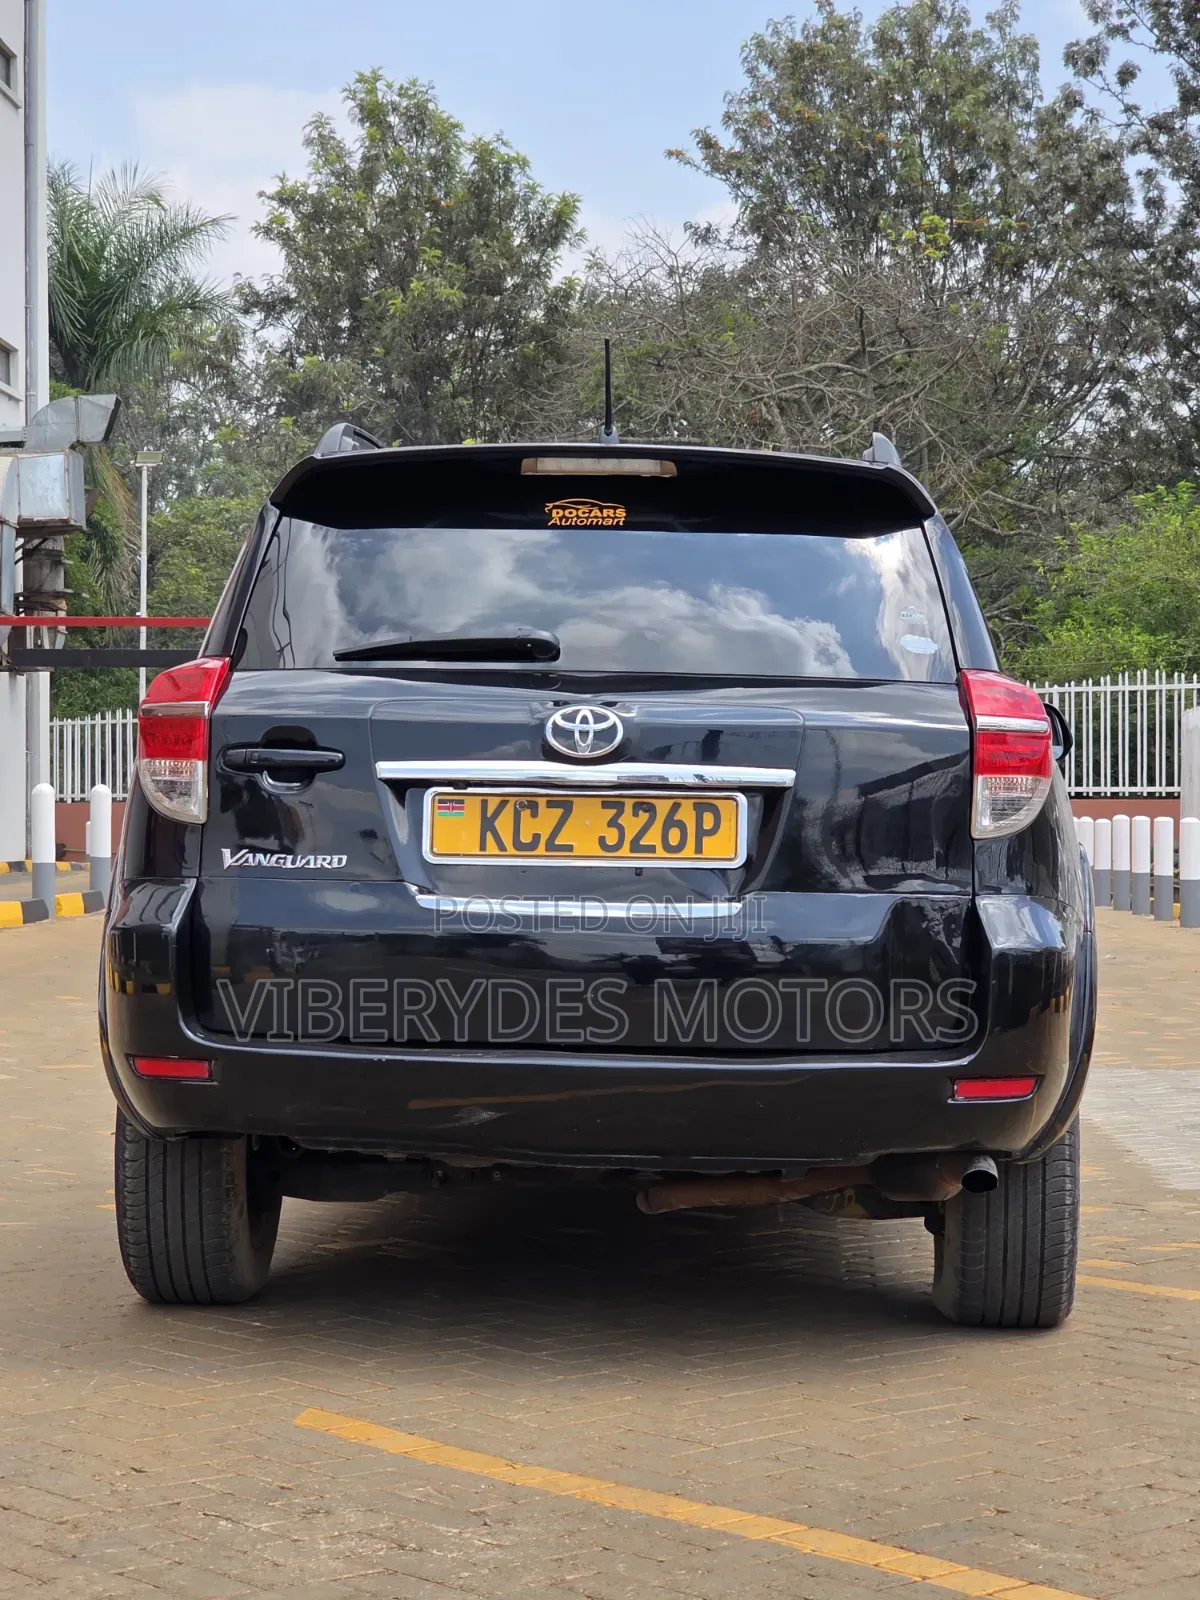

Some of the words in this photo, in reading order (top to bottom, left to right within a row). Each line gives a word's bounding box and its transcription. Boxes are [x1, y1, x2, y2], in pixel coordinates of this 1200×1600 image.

[551, 509, 626, 517] DOCARS
[548, 517, 625, 526] Automart
[479, 799, 574, 853] KCZ
[598, 801, 722, 855] 326P
[220, 848, 348, 870] VANGUARD
